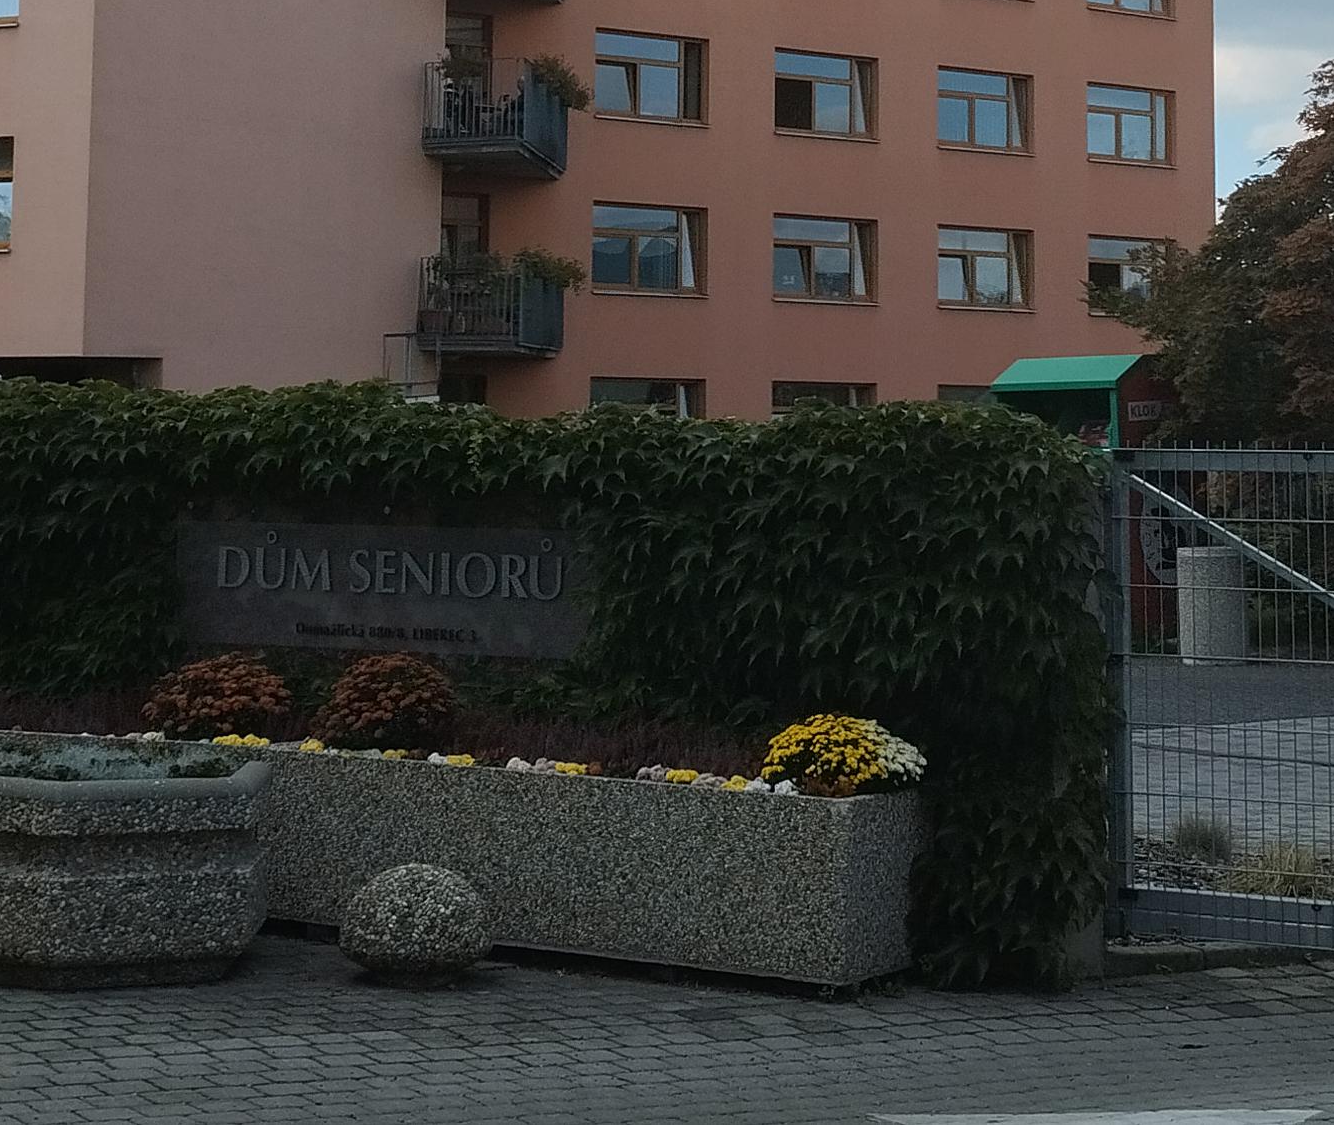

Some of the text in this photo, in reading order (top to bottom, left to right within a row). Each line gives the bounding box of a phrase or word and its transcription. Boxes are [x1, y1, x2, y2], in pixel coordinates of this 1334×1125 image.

[217, 530, 564, 601] DŮM SENIORŮ
[412, 627, 465, 643] LIBEREC
